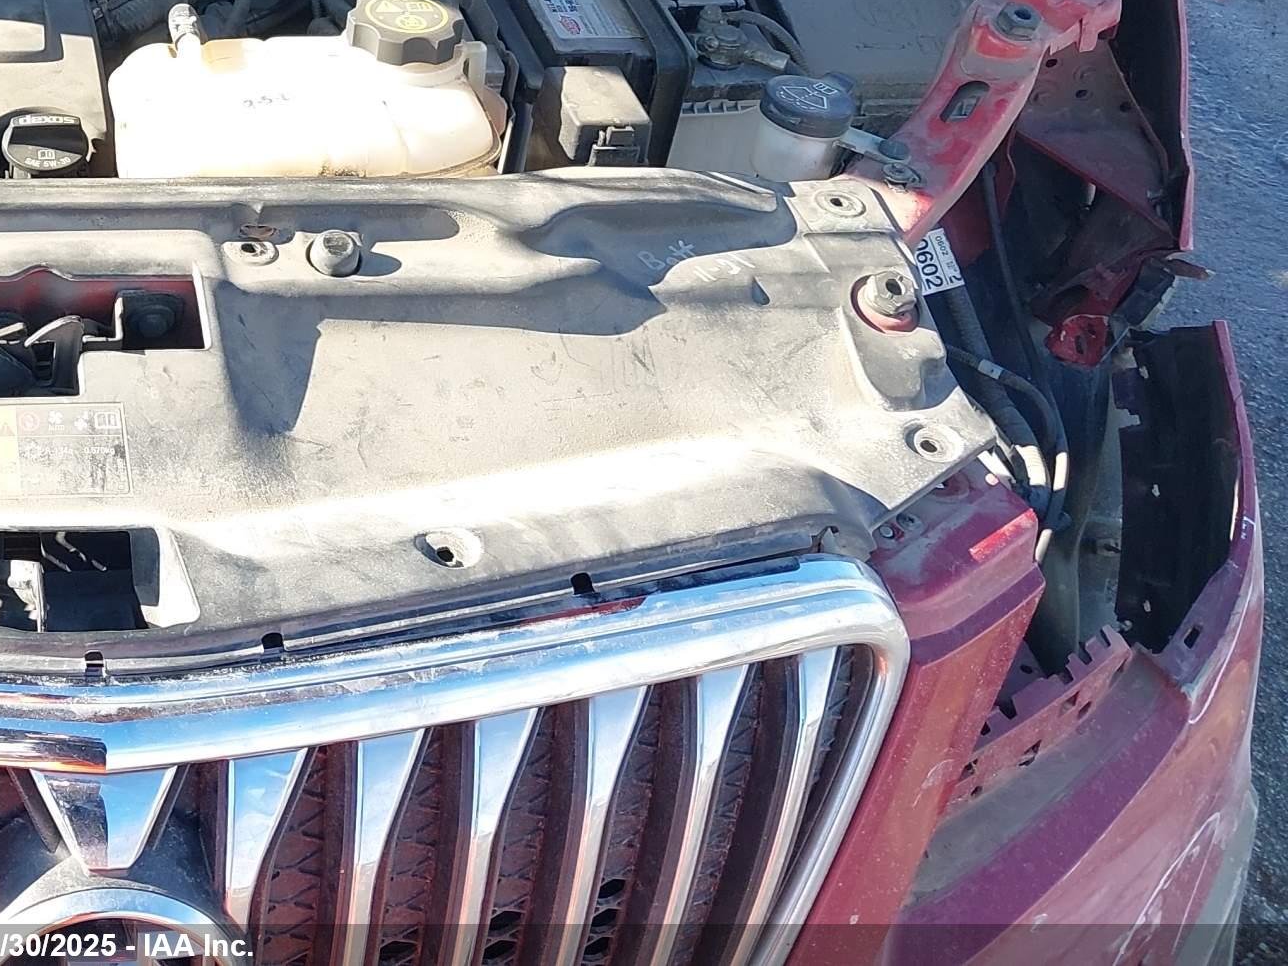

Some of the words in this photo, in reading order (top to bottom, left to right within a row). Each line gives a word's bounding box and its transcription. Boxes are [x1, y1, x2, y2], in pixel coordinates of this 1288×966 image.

[18, 114, 75, 125] dexos
[24, 157, 41, 168] SAE
[43, 156, 72, 168] 5W-30
